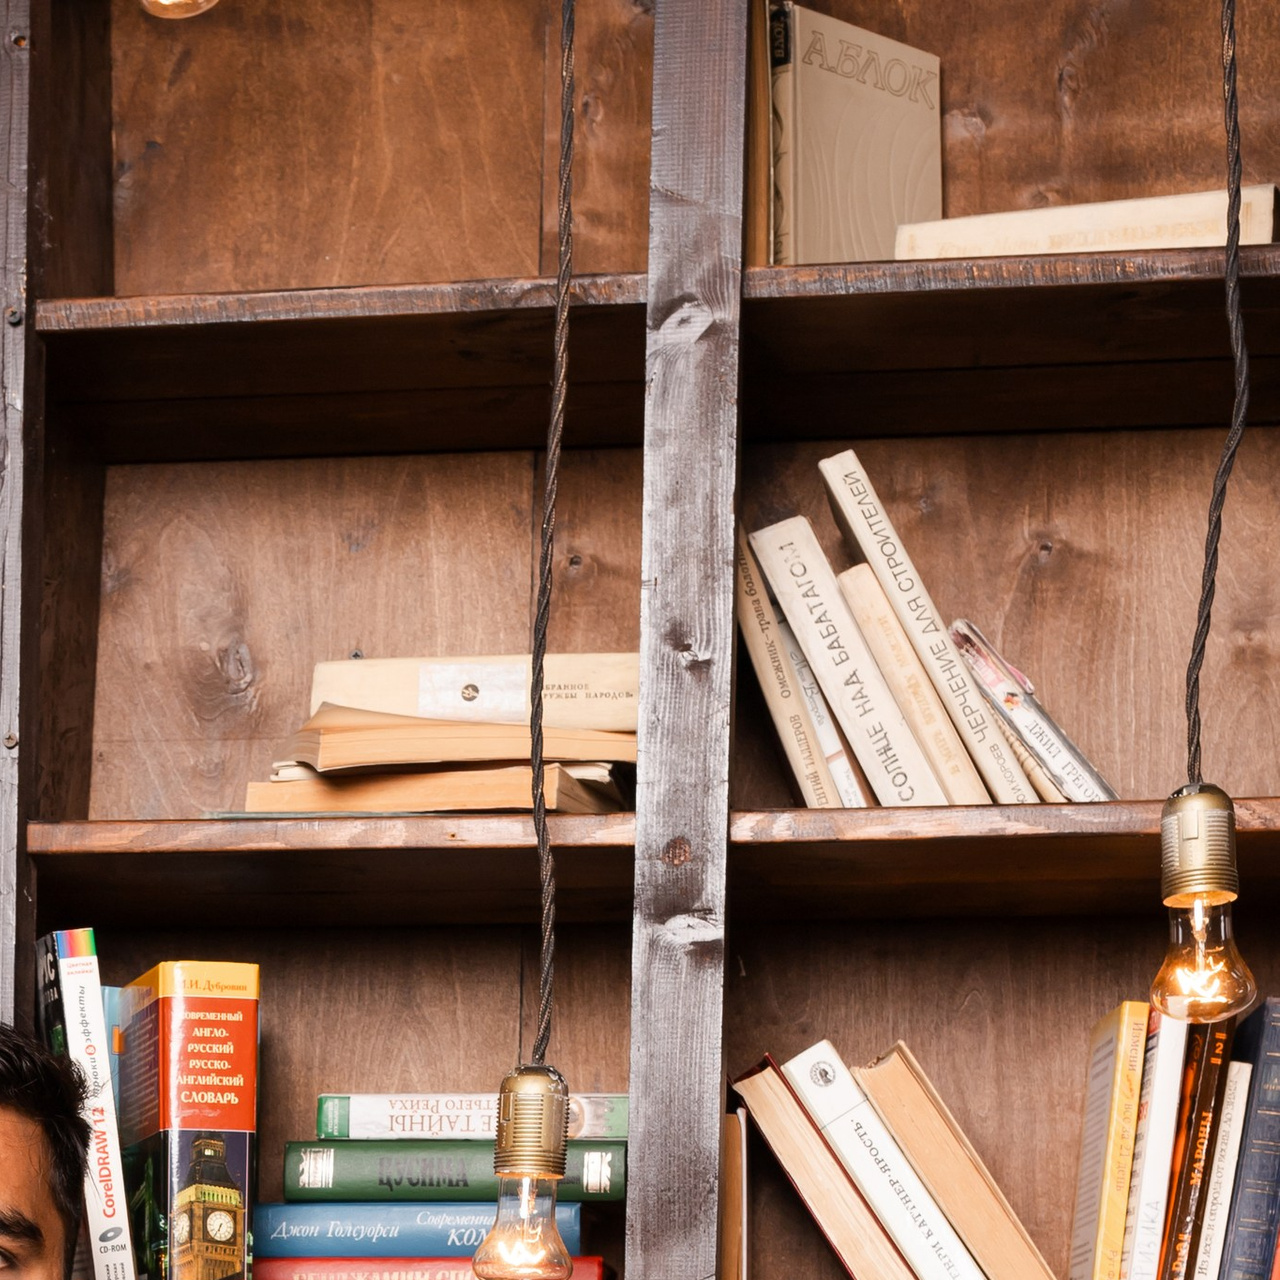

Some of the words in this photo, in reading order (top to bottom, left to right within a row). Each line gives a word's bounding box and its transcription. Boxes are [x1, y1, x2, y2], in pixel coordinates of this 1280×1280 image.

[836, 467, 920, 595] СТРОИТЕЛЕЙ
[778, 539, 851, 668] БАБАТАГОМ
[905, 593, 940, 637] ДЛЯ
[840, 668, 876, 719] НАД
[925, 637, 997, 744] ЧЕРЧЕНИЕ
[1022, 717, 1061, 759] ДЖИЛ
[865, 719, 917, 804] СОЛНЦЕ
[203, 980, 248, 992] Дубровин
[73, 982, 94, 1043] эффекты
[192, 1027, 229, 1038] АНГЛО-
[187, 1041, 234, 1054] РУССКИЙ
[1126, 1020, 1145, 1074] Измени
[189, 1059, 232, 1070] РУССКО-
[177, 1073, 244, 1087] АНГЛИЙСКИЙ
[180, 1091, 239, 1105] СЛОВАРЬ
[90, 1106, 106, 1125] 12
[388, 1115, 476, 1136] ТАЙНЫ
[1119, 1127, 1131, 1143] за
[1185, 1108, 1217, 1188] МАРОНЫ
[1117, 1143, 1133, 1159] 21
[91, 1130, 117, 1220] CorelDRAW
[378, 1156, 470, 1192] ЦУСИМА
[1112, 1160, 1128, 1193] день
[271, 1219, 319, 1240] Джон
[326, 1220, 401, 1241] Голсуорси
[97, 1241, 127, 1255] CD-ROM
[1105, 1247, 1120, 1269] Рут
[1168, 1241, 1191, 1275] Рид
[1196, 1258, 1210, 1276] Из
